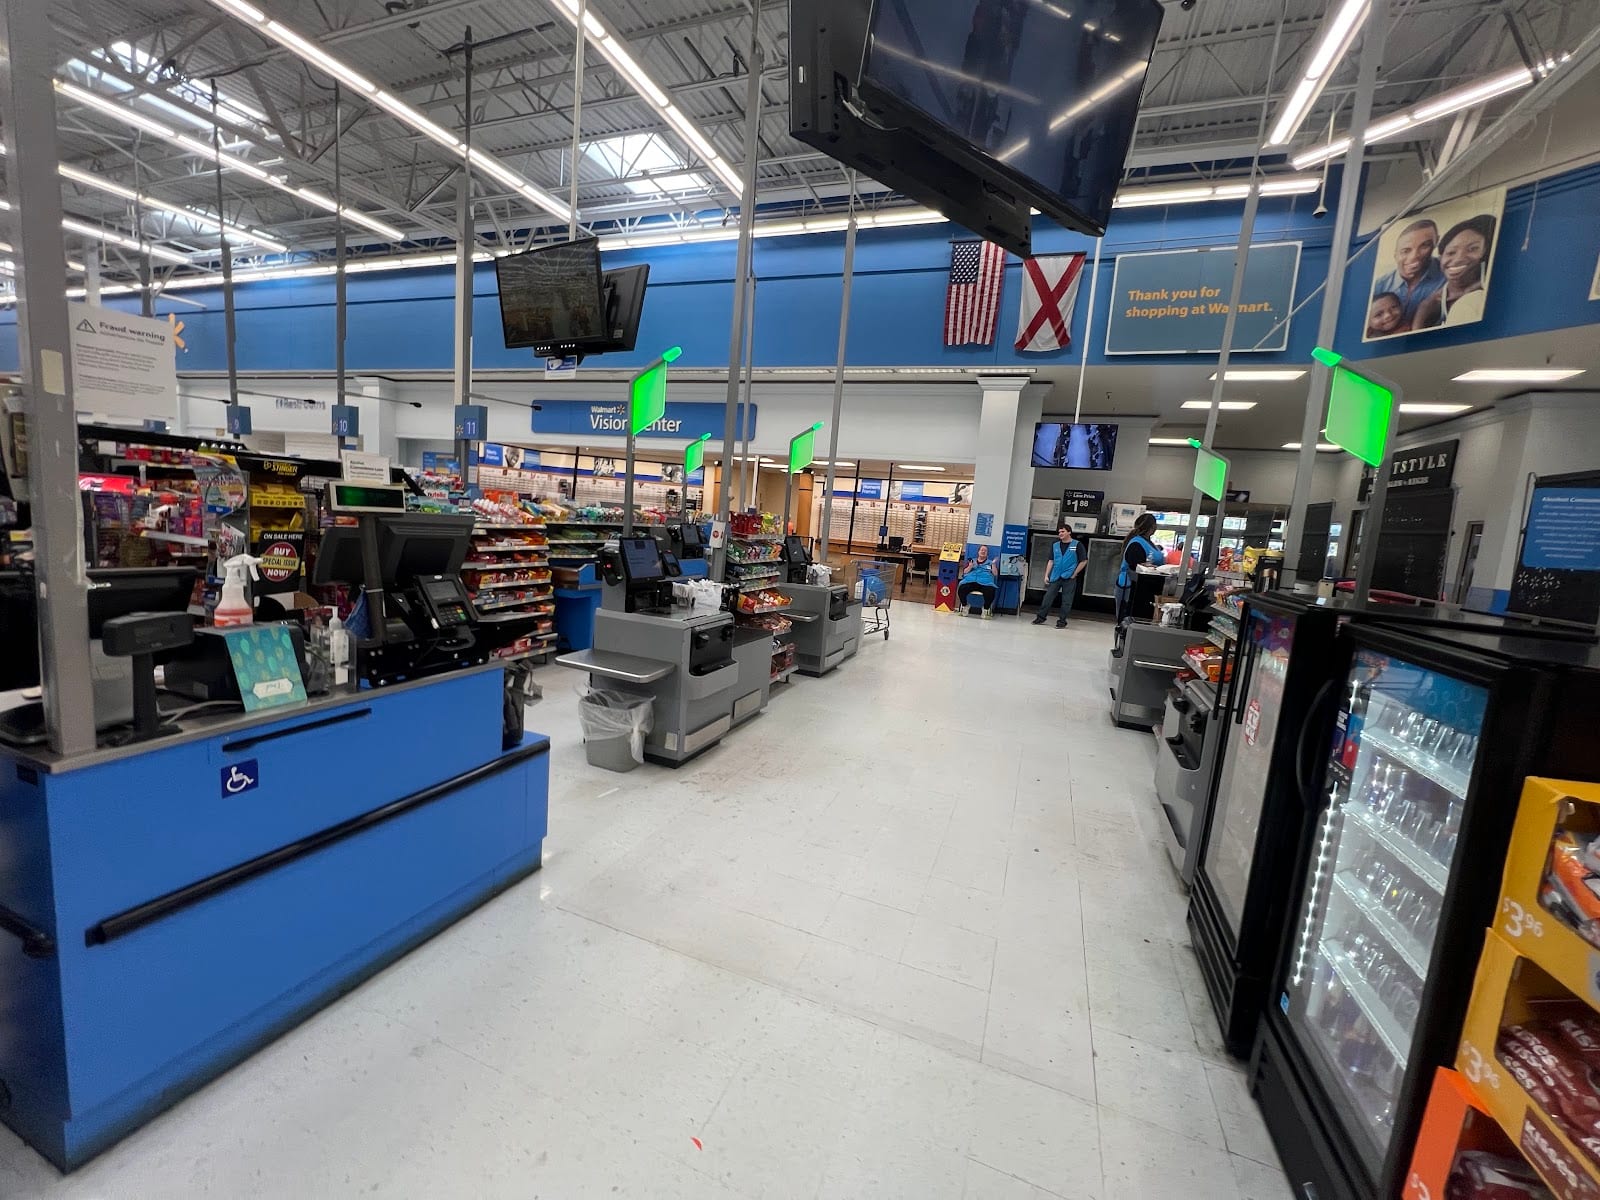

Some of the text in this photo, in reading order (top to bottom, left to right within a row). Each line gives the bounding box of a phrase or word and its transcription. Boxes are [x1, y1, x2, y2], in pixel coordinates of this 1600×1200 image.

[1128, 286, 1220, 301] Thank you for
[1125, 302, 1273, 319] shopping at Wamart.
[99, 321, 127, 333] Fraud
[129, 328, 166, 342] warning
[591, 405, 617, 414] Walmart
[234, 418, 241, 430] 9
[339, 420, 348, 433] 10
[466, 421, 476, 435] 11
[644, 417, 682, 433] nter
[273, 547, 291, 556] BUY
[263, 556, 297, 567] SPECIAL ISSUE
[267, 568, 289, 577] NOW!
